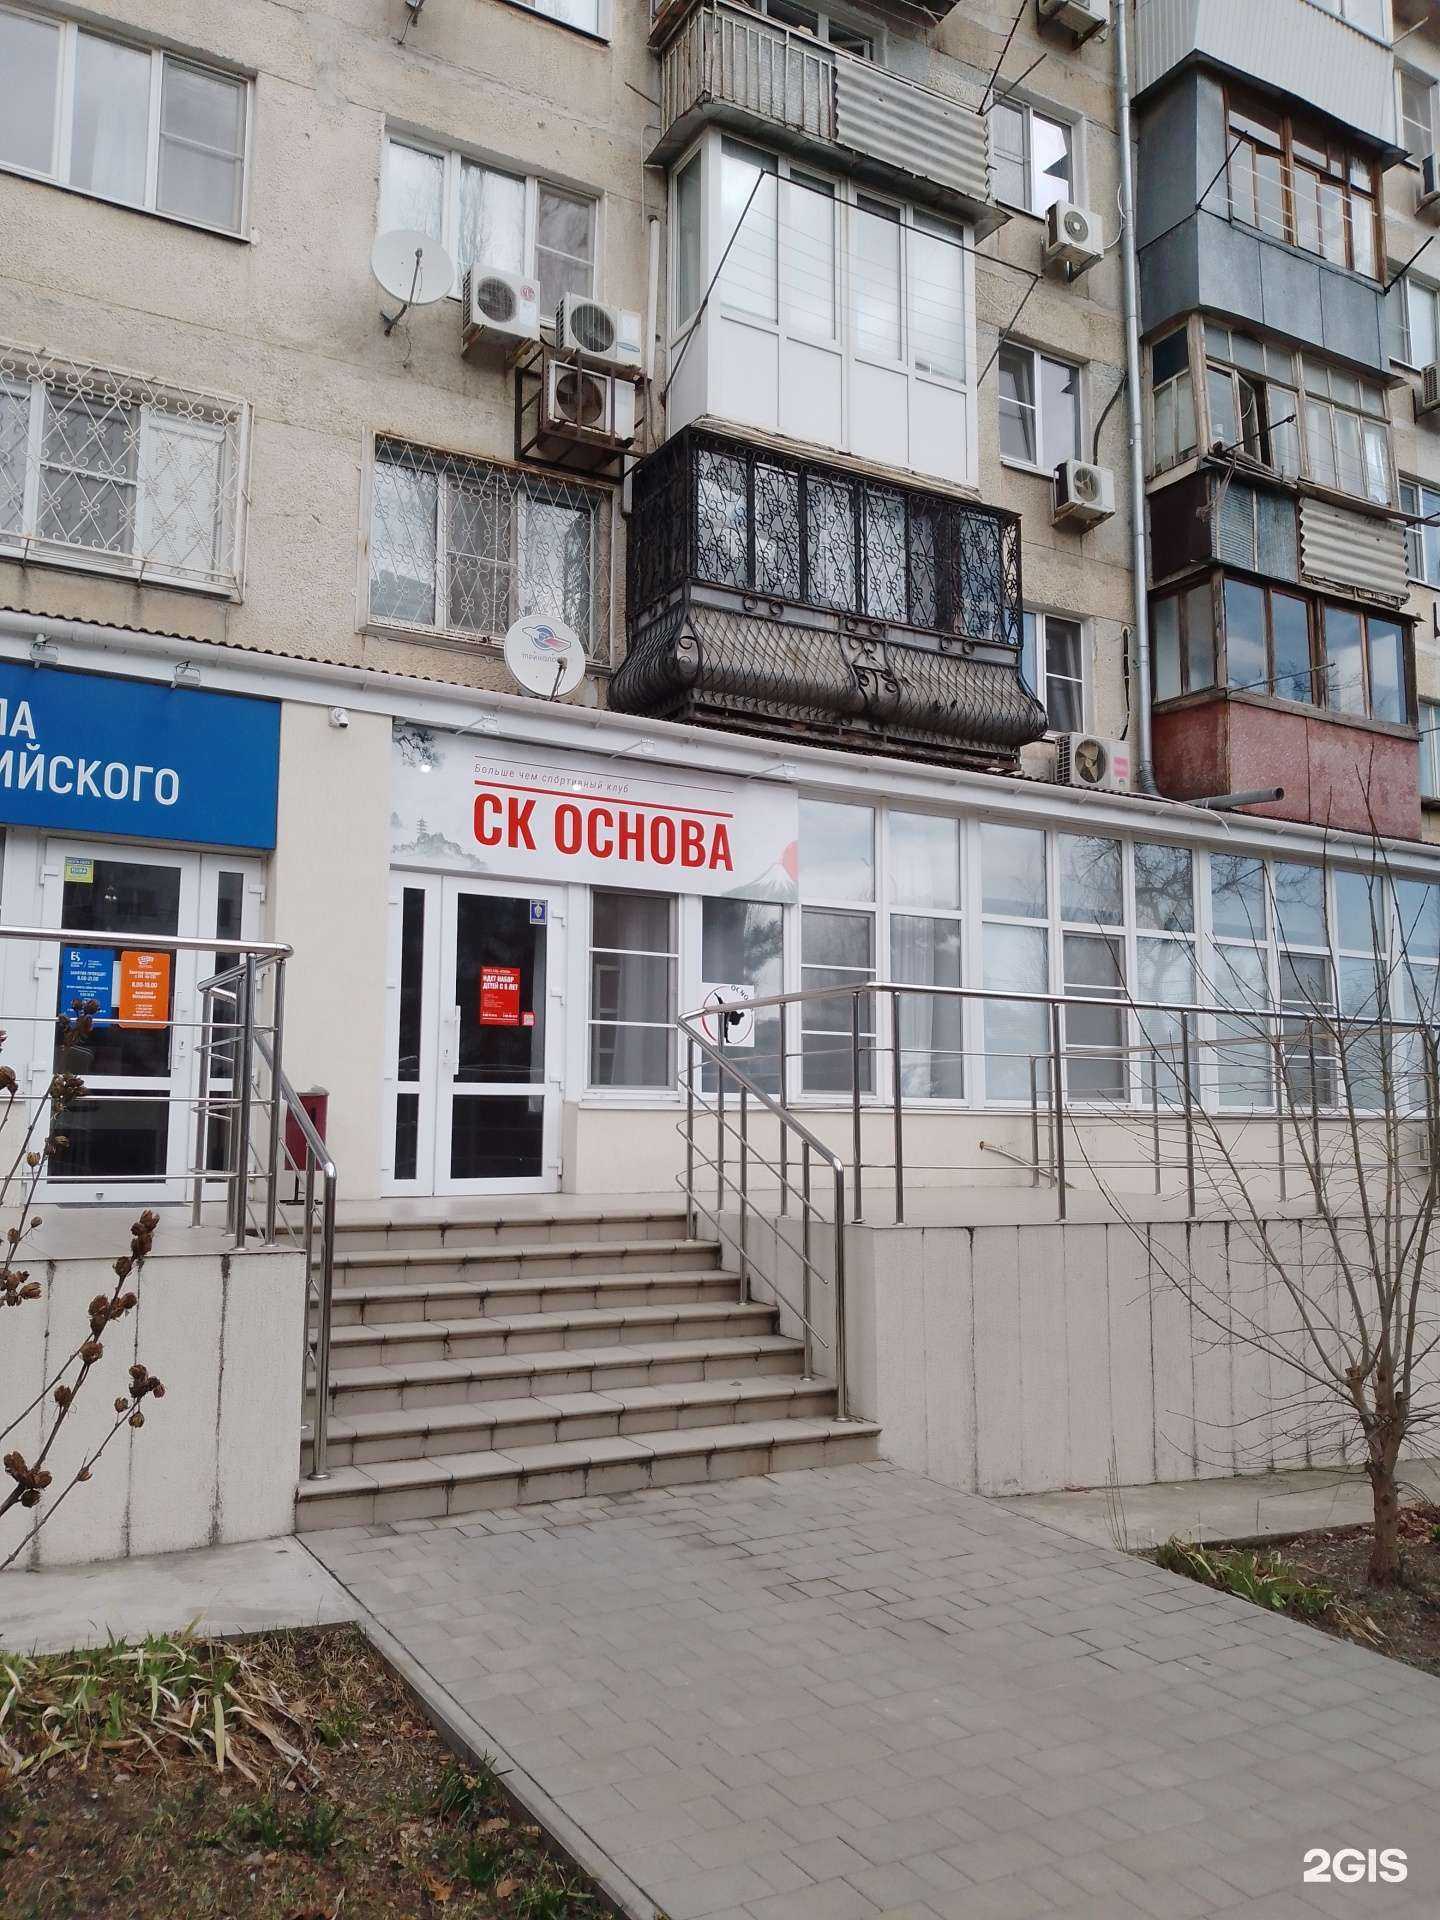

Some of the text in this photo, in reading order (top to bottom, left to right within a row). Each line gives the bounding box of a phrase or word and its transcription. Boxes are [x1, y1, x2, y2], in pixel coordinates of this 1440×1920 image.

[0, 697, 36, 740] А
[474, 763, 630, 794] Больше чем спортивный клуб
[473, 793, 734, 872] СК ОСНОВА
